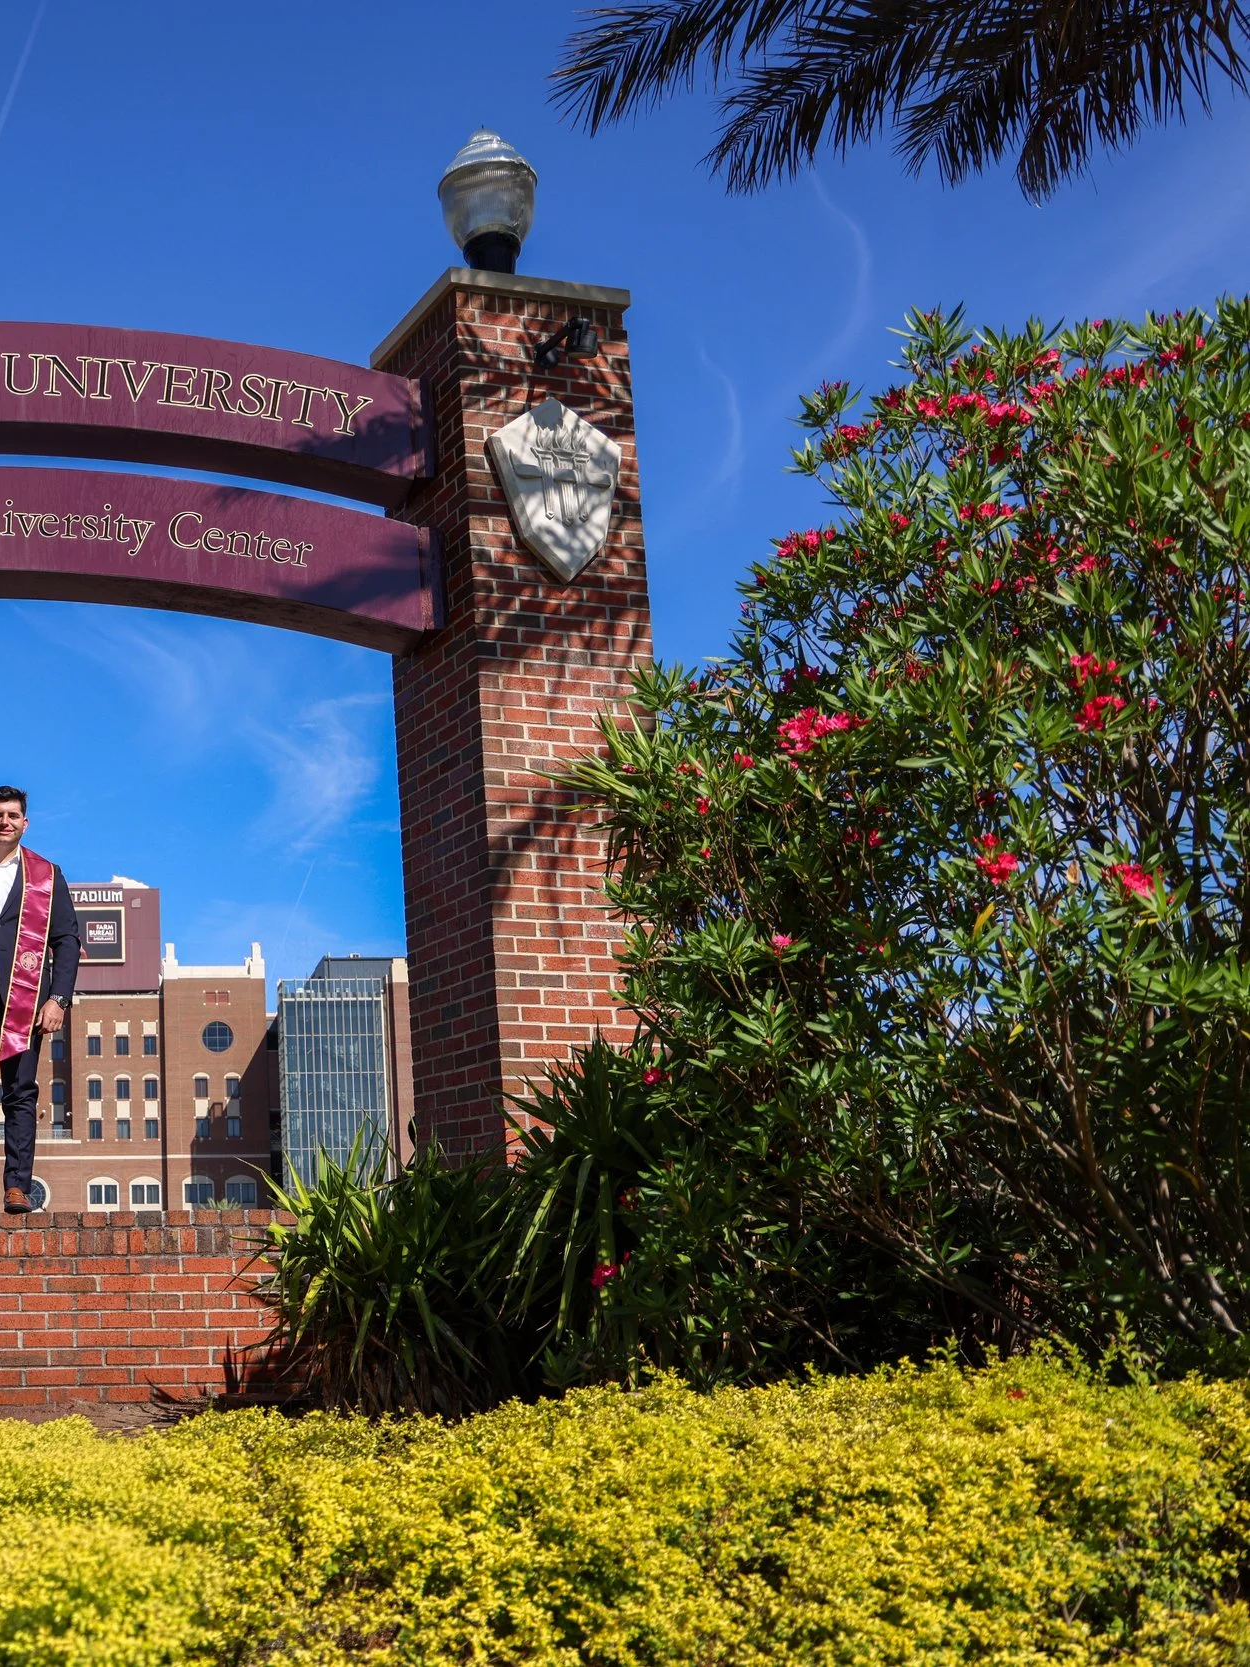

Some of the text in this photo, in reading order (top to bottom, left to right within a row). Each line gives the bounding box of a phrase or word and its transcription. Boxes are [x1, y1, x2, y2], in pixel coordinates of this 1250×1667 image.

[0, 353, 373, 437] UNIVERSITY
[167, 511, 313, 568] Center
[69, 890, 123, 902] TADIUM
